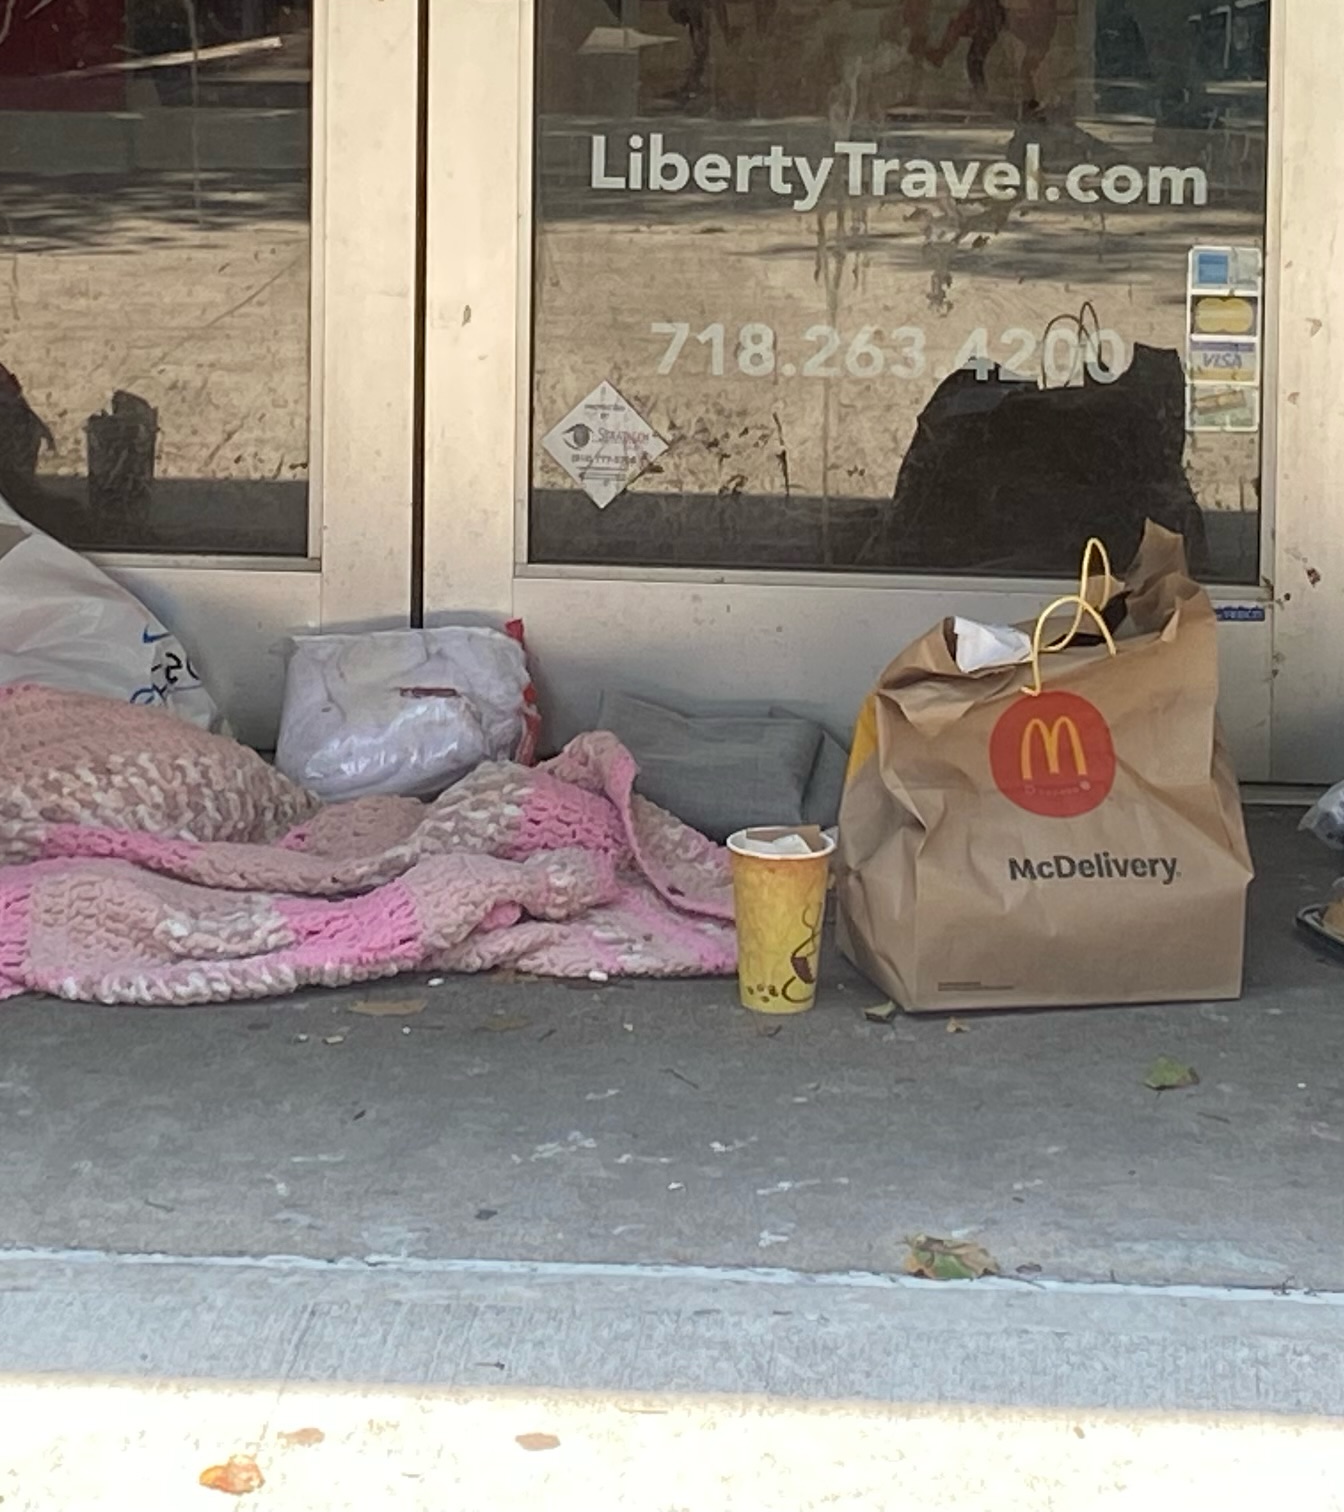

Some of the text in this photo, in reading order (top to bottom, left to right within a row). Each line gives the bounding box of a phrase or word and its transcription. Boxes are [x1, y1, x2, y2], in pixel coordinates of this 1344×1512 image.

[591, 132, 1208, 212] LibertyTravel.com
[651, 322, 1133, 385] 718.263.4200
[1202, 352, 1243, 369] VISA
[1008, 851, 1179, 886] McDelivery
